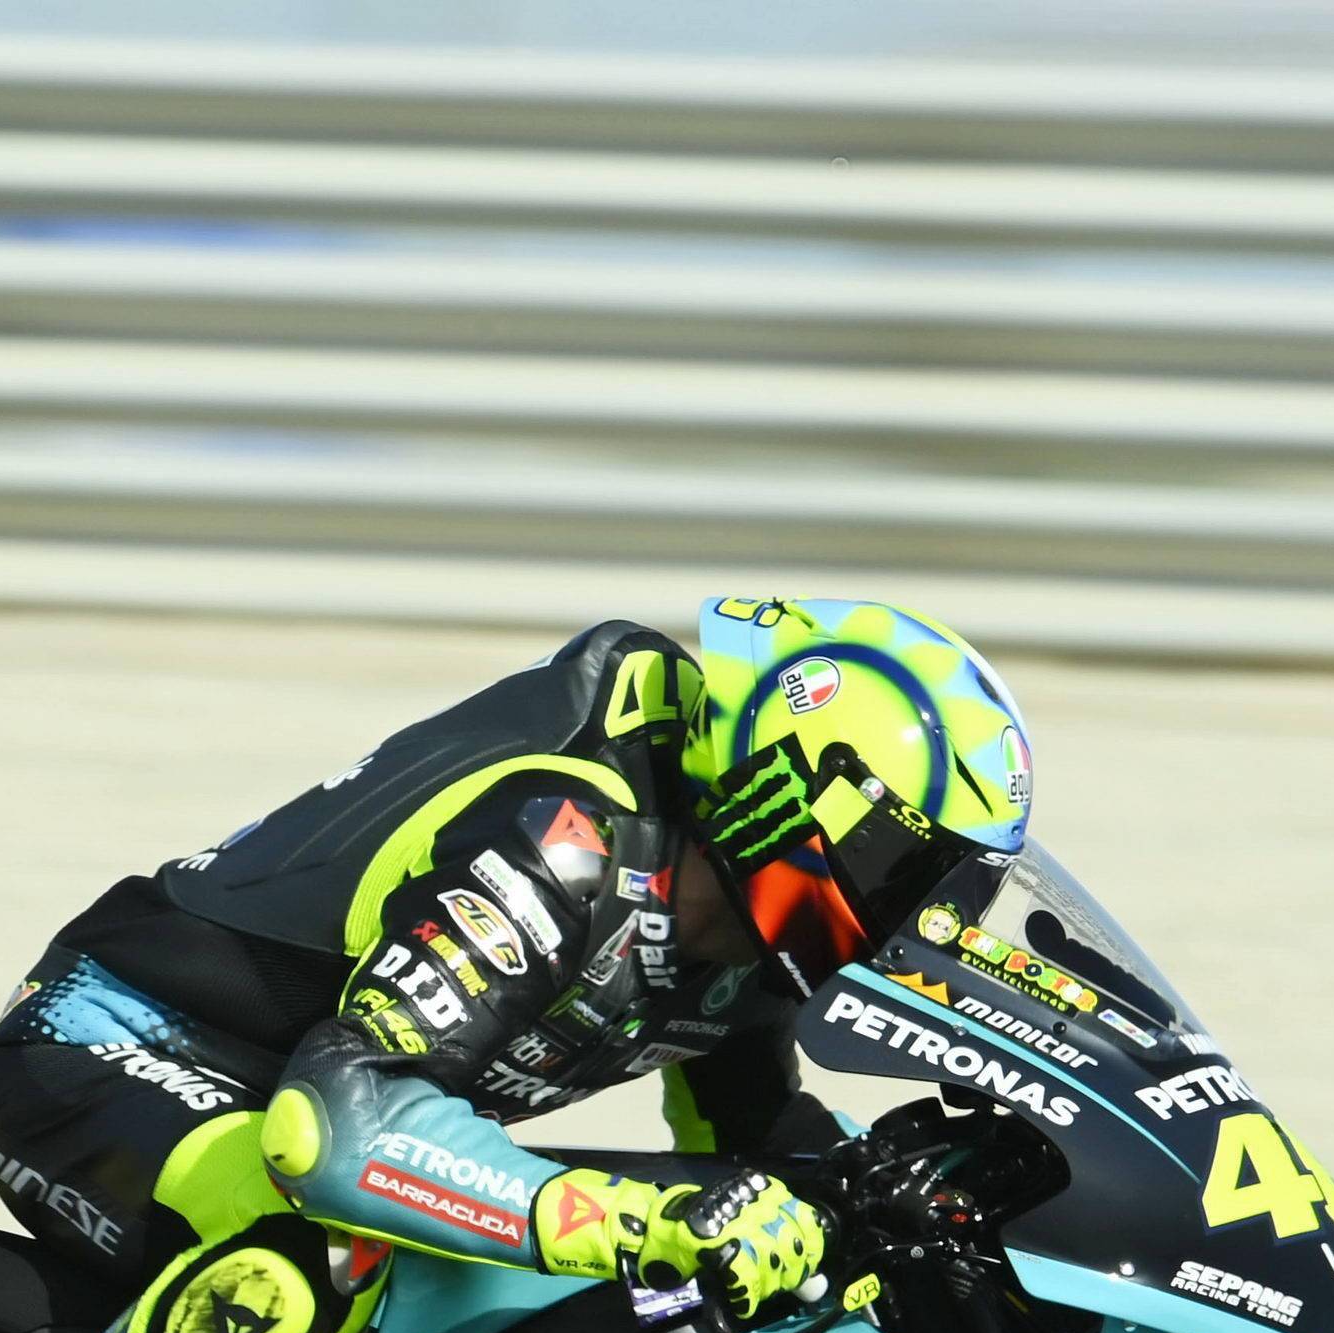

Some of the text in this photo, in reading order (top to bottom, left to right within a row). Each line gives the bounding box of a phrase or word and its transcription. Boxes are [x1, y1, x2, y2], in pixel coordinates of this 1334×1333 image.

[823, 992, 1080, 1126] PETRONAS
[367, 1171, 519, 1241] BARRACUDA
[1170, 1276, 1295, 1327] RACING TEAM
[1176, 1261, 1304, 1318] SEPANG
